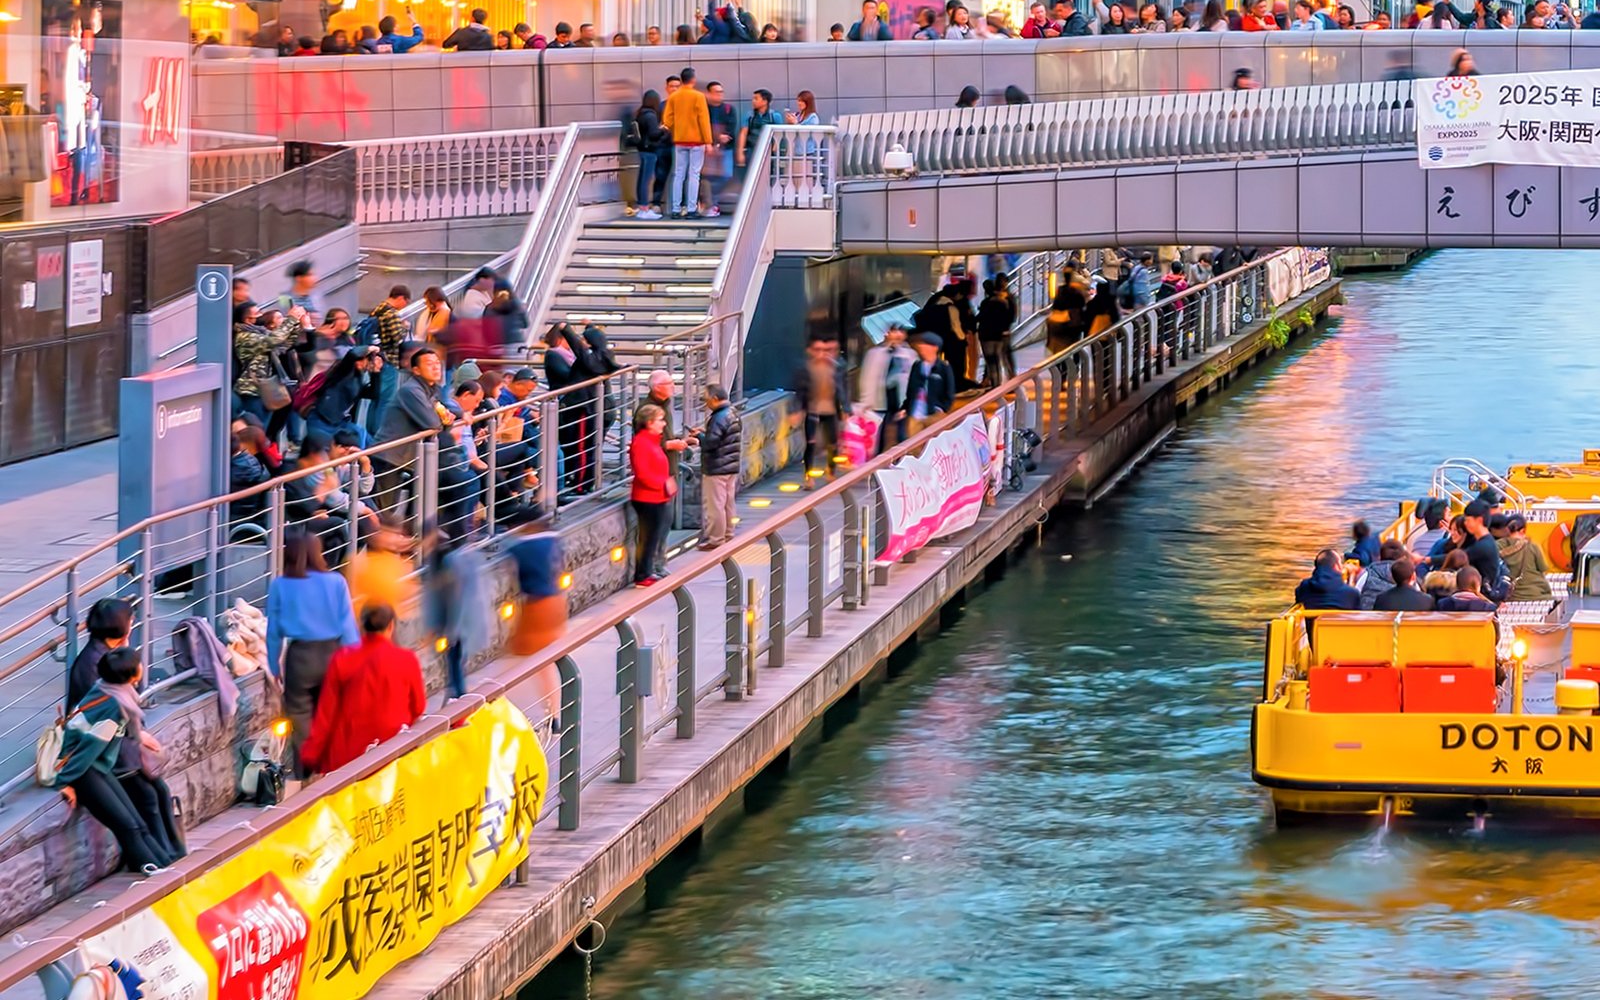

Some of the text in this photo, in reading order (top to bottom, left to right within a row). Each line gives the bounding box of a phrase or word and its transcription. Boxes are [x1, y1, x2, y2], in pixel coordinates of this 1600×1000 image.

[1498, 84, 1584, 107] 2025年
[1440, 723, 1593, 752] DOTON
[1491, 757, 1543, 775] 大阪
